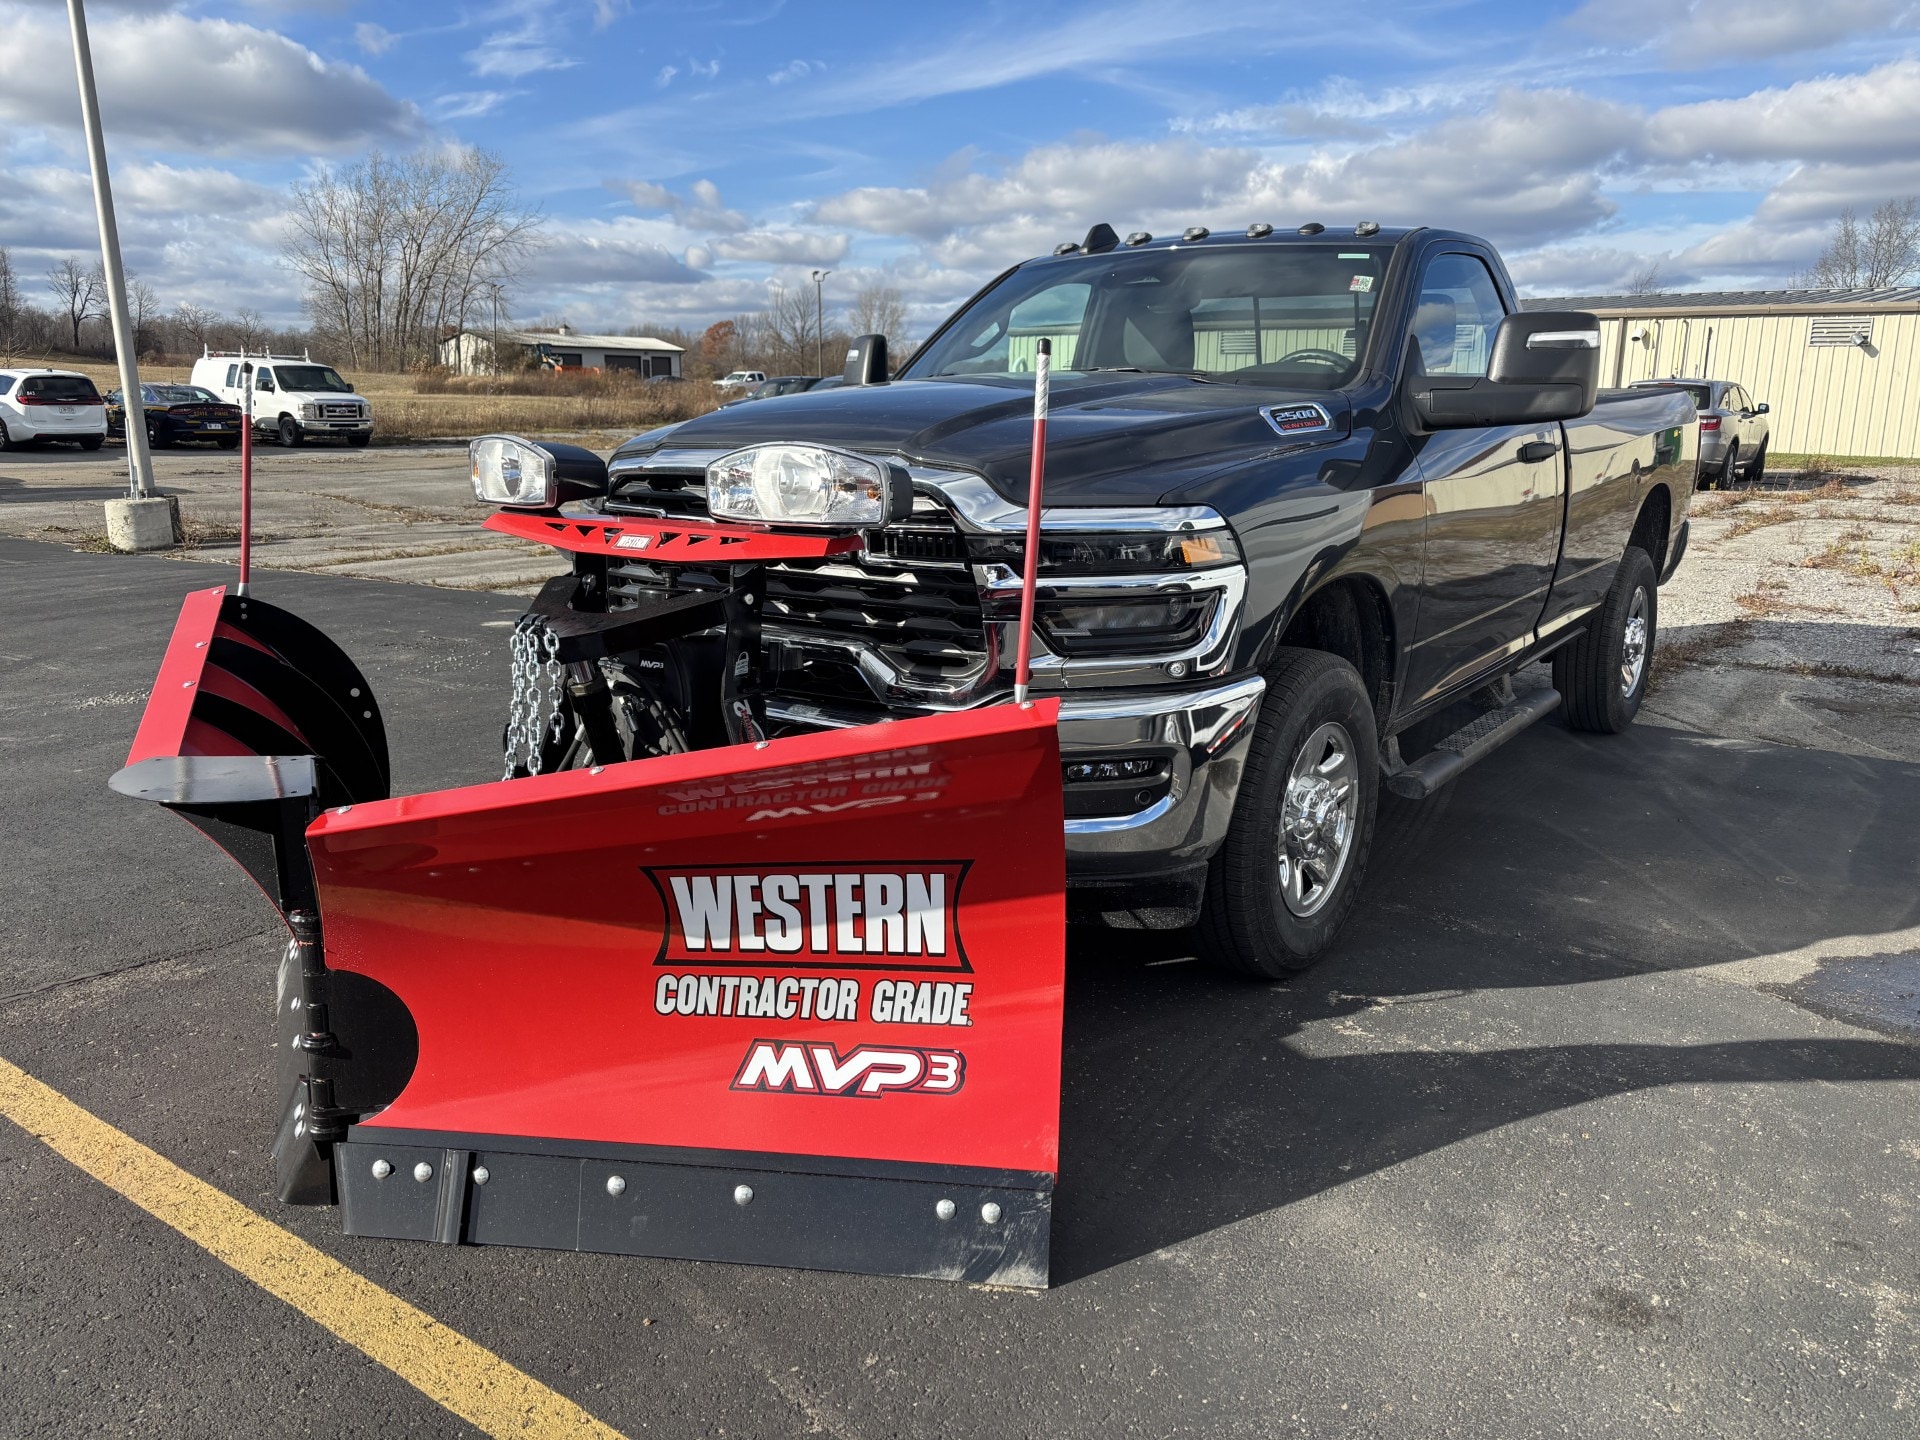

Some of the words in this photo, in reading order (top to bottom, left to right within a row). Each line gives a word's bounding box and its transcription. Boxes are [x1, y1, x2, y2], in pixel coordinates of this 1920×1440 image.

[1275, 409, 1318, 421] 2500
[1281, 422, 1304, 430] HEAVY
[1305, 420, 1322, 428] DUTY
[640, 659, 664, 669] MVP3
[668, 872, 946, 955] WESTERN
[654, 973, 861, 1022] CONTRACTOR
[870, 979, 974, 1025] GRADE
[733, 1041, 964, 1095] MVP3
